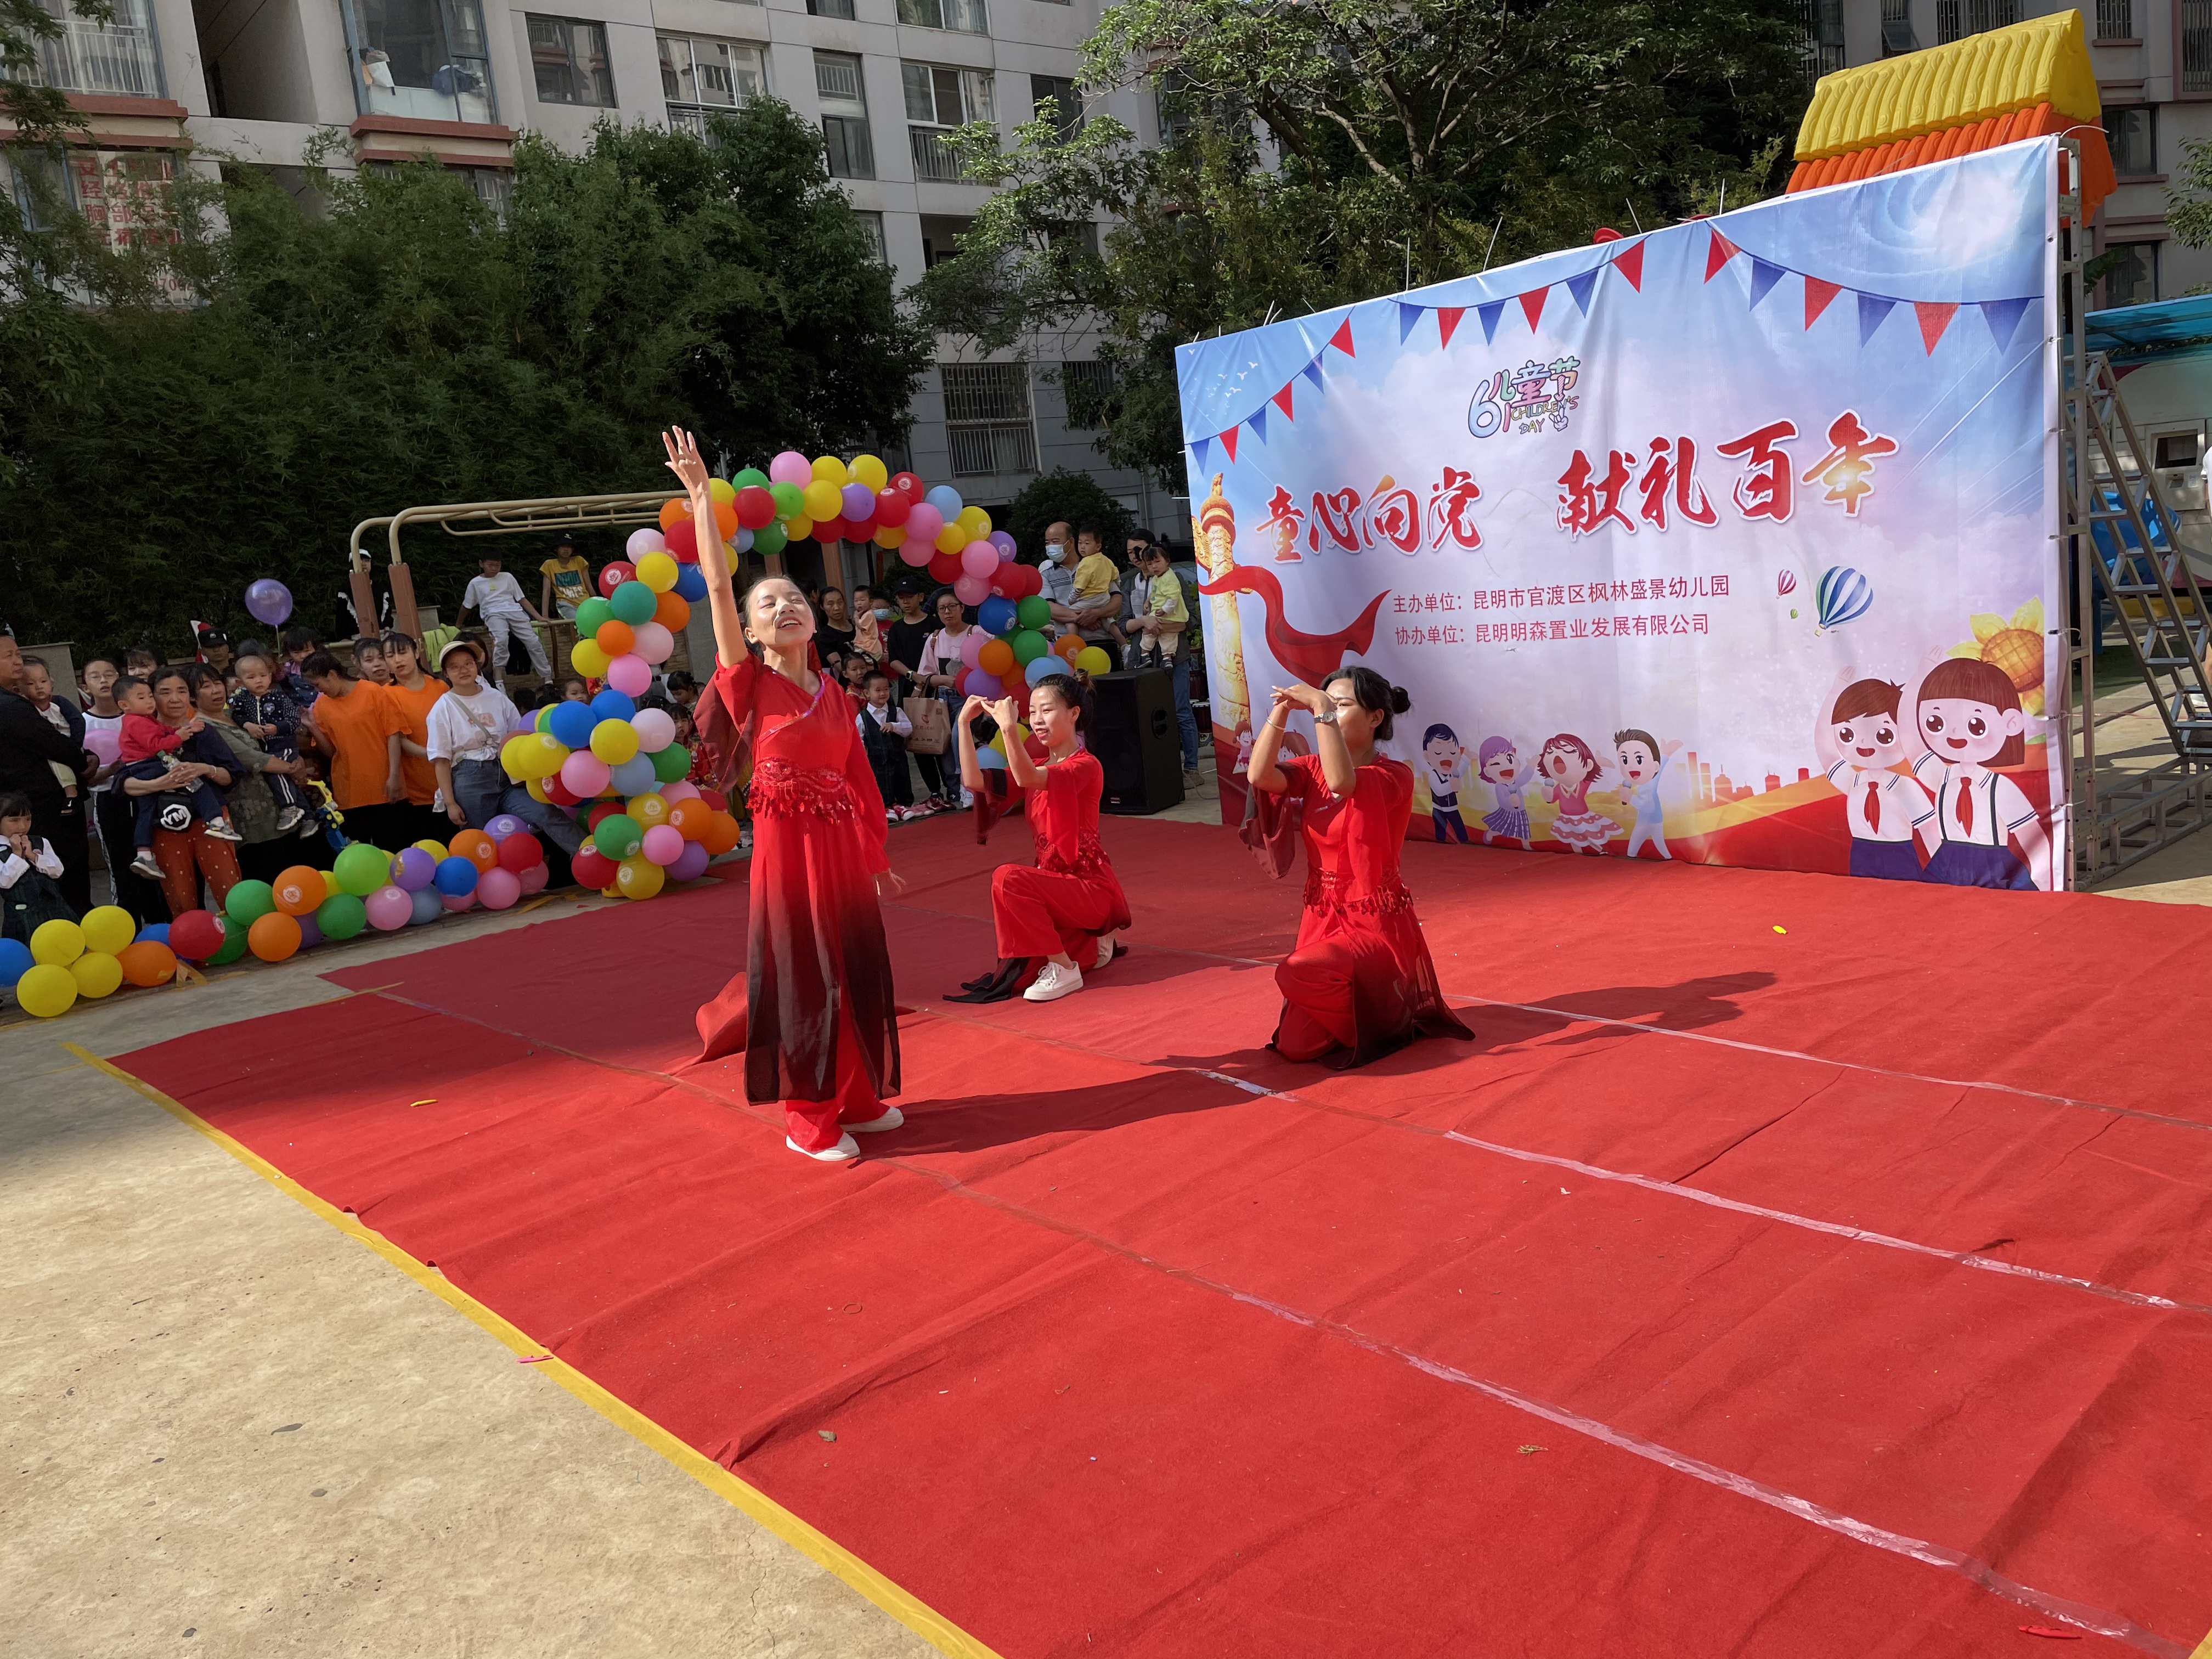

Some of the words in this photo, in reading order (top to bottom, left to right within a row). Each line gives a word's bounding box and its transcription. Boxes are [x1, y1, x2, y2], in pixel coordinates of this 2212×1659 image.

[1488, 356, 1581, 409] 儿童节
[1511, 396, 1580, 421] CHILDREN'S
[1519, 418, 1545, 435] DAY
[1256, 465, 1483, 562] 童心向党
[1557, 410, 1899, 540] 献礼百年
